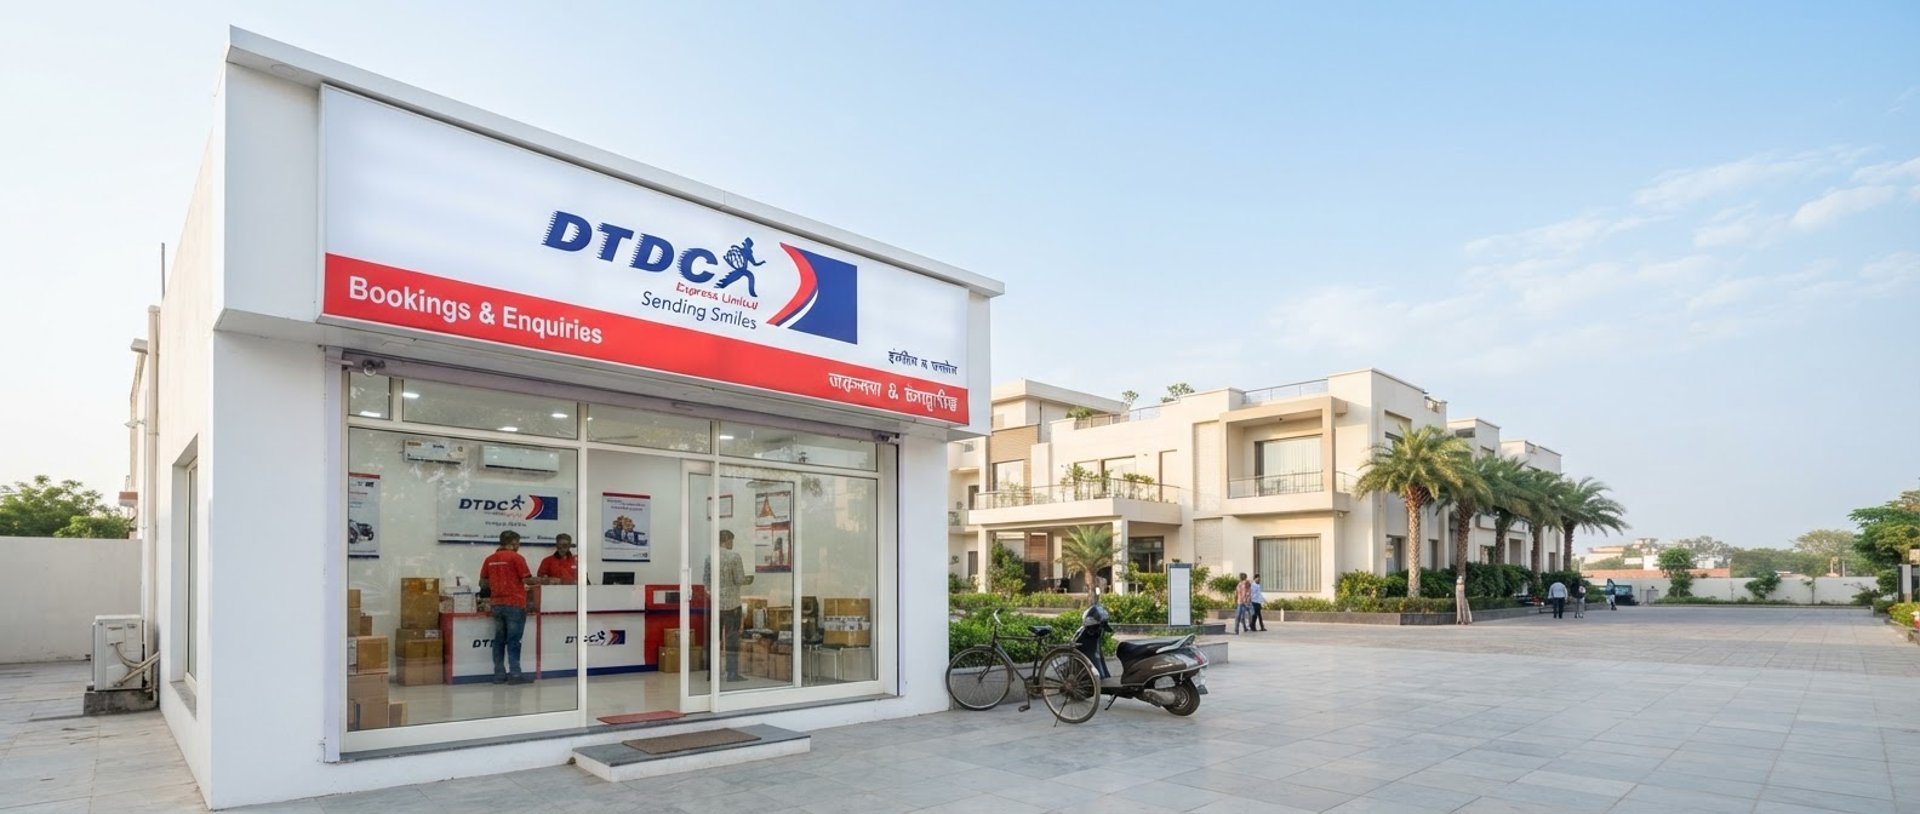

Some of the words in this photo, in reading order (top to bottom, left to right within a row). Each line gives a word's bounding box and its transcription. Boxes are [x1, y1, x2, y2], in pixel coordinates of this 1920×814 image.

[541, 210, 718, 284] DTDC
[349, 275, 471, 323] Bookings
[478, 301, 496, 326] &
[503, 306, 603, 345] Enquiries
[641, 290, 707, 322] Sending
[710, 306, 757, 330] Smiles
[458, 498, 509, 511] DTDC
